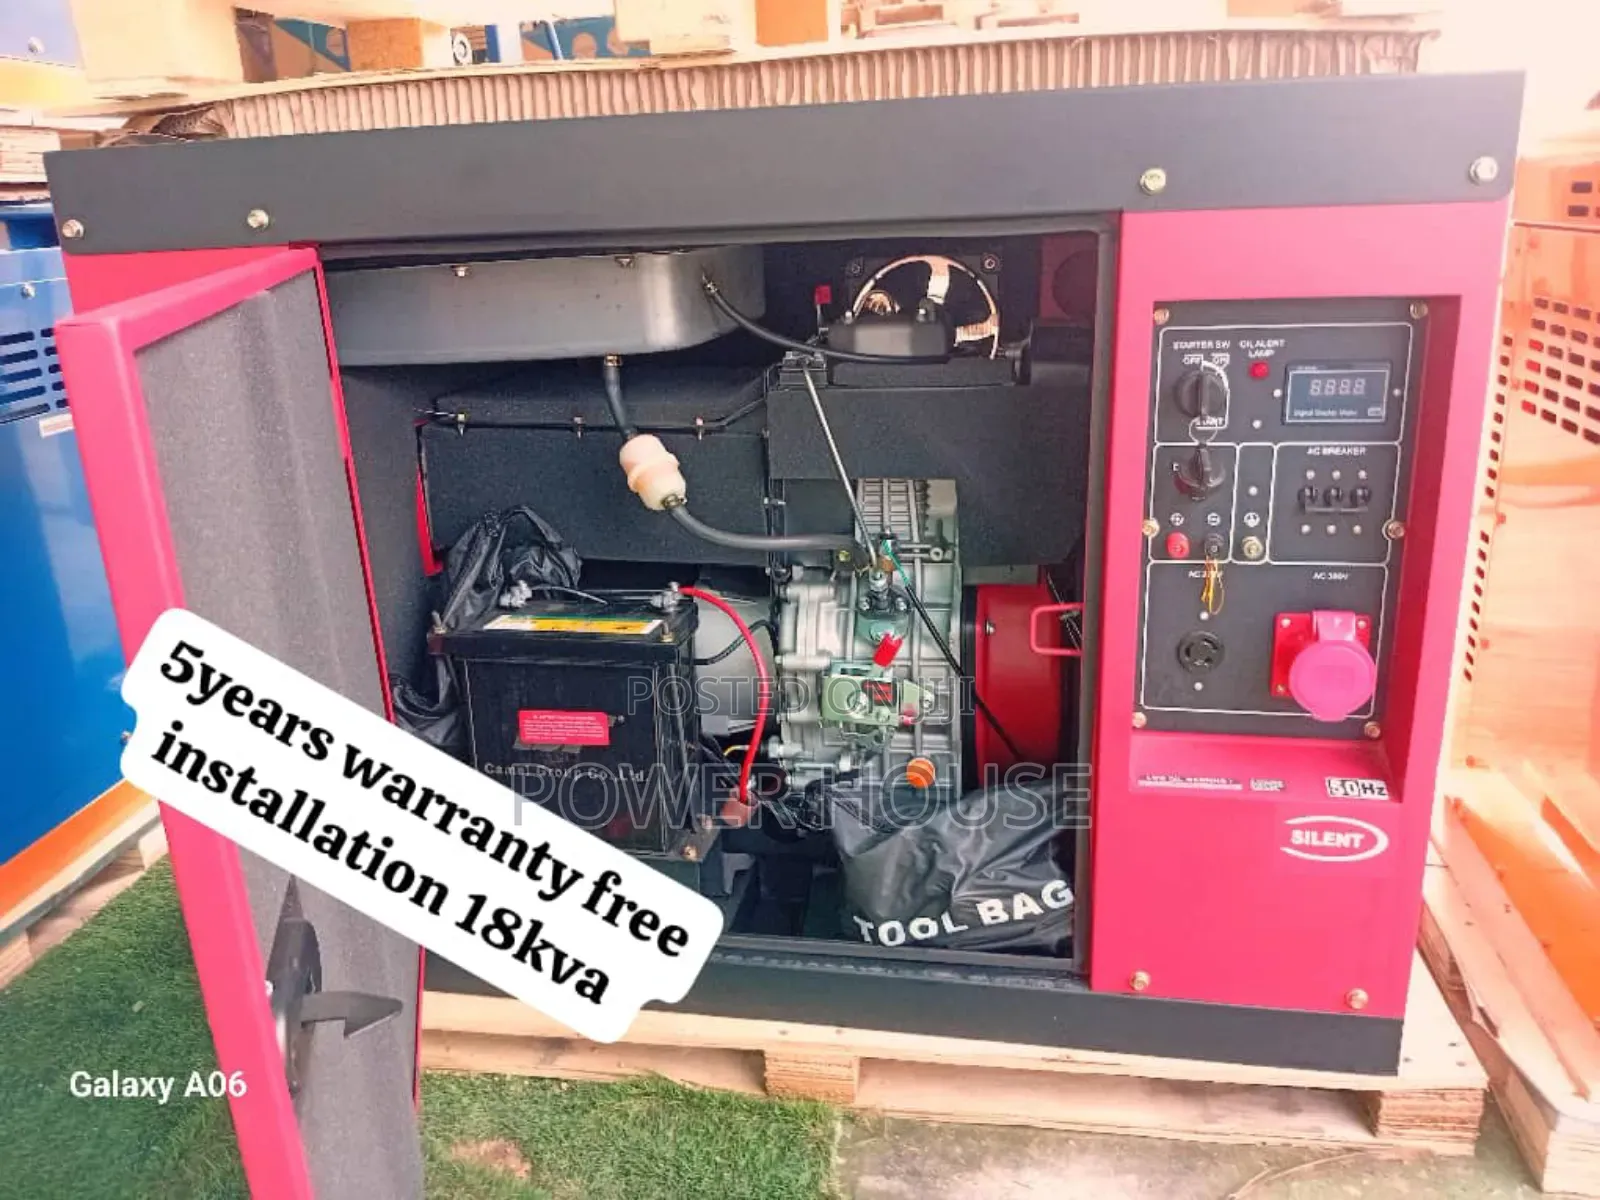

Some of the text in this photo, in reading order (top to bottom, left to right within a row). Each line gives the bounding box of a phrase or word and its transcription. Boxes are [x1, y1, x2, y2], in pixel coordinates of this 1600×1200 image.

[1173, 341, 1214, 349] STARTER
[1322, 446, 1367, 456] BREAKER
[1328, 779, 1387, 797] 50Hz
[1291, 829, 1364, 848] SILENT
[853, 879, 1074, 947] TOOL BAG
